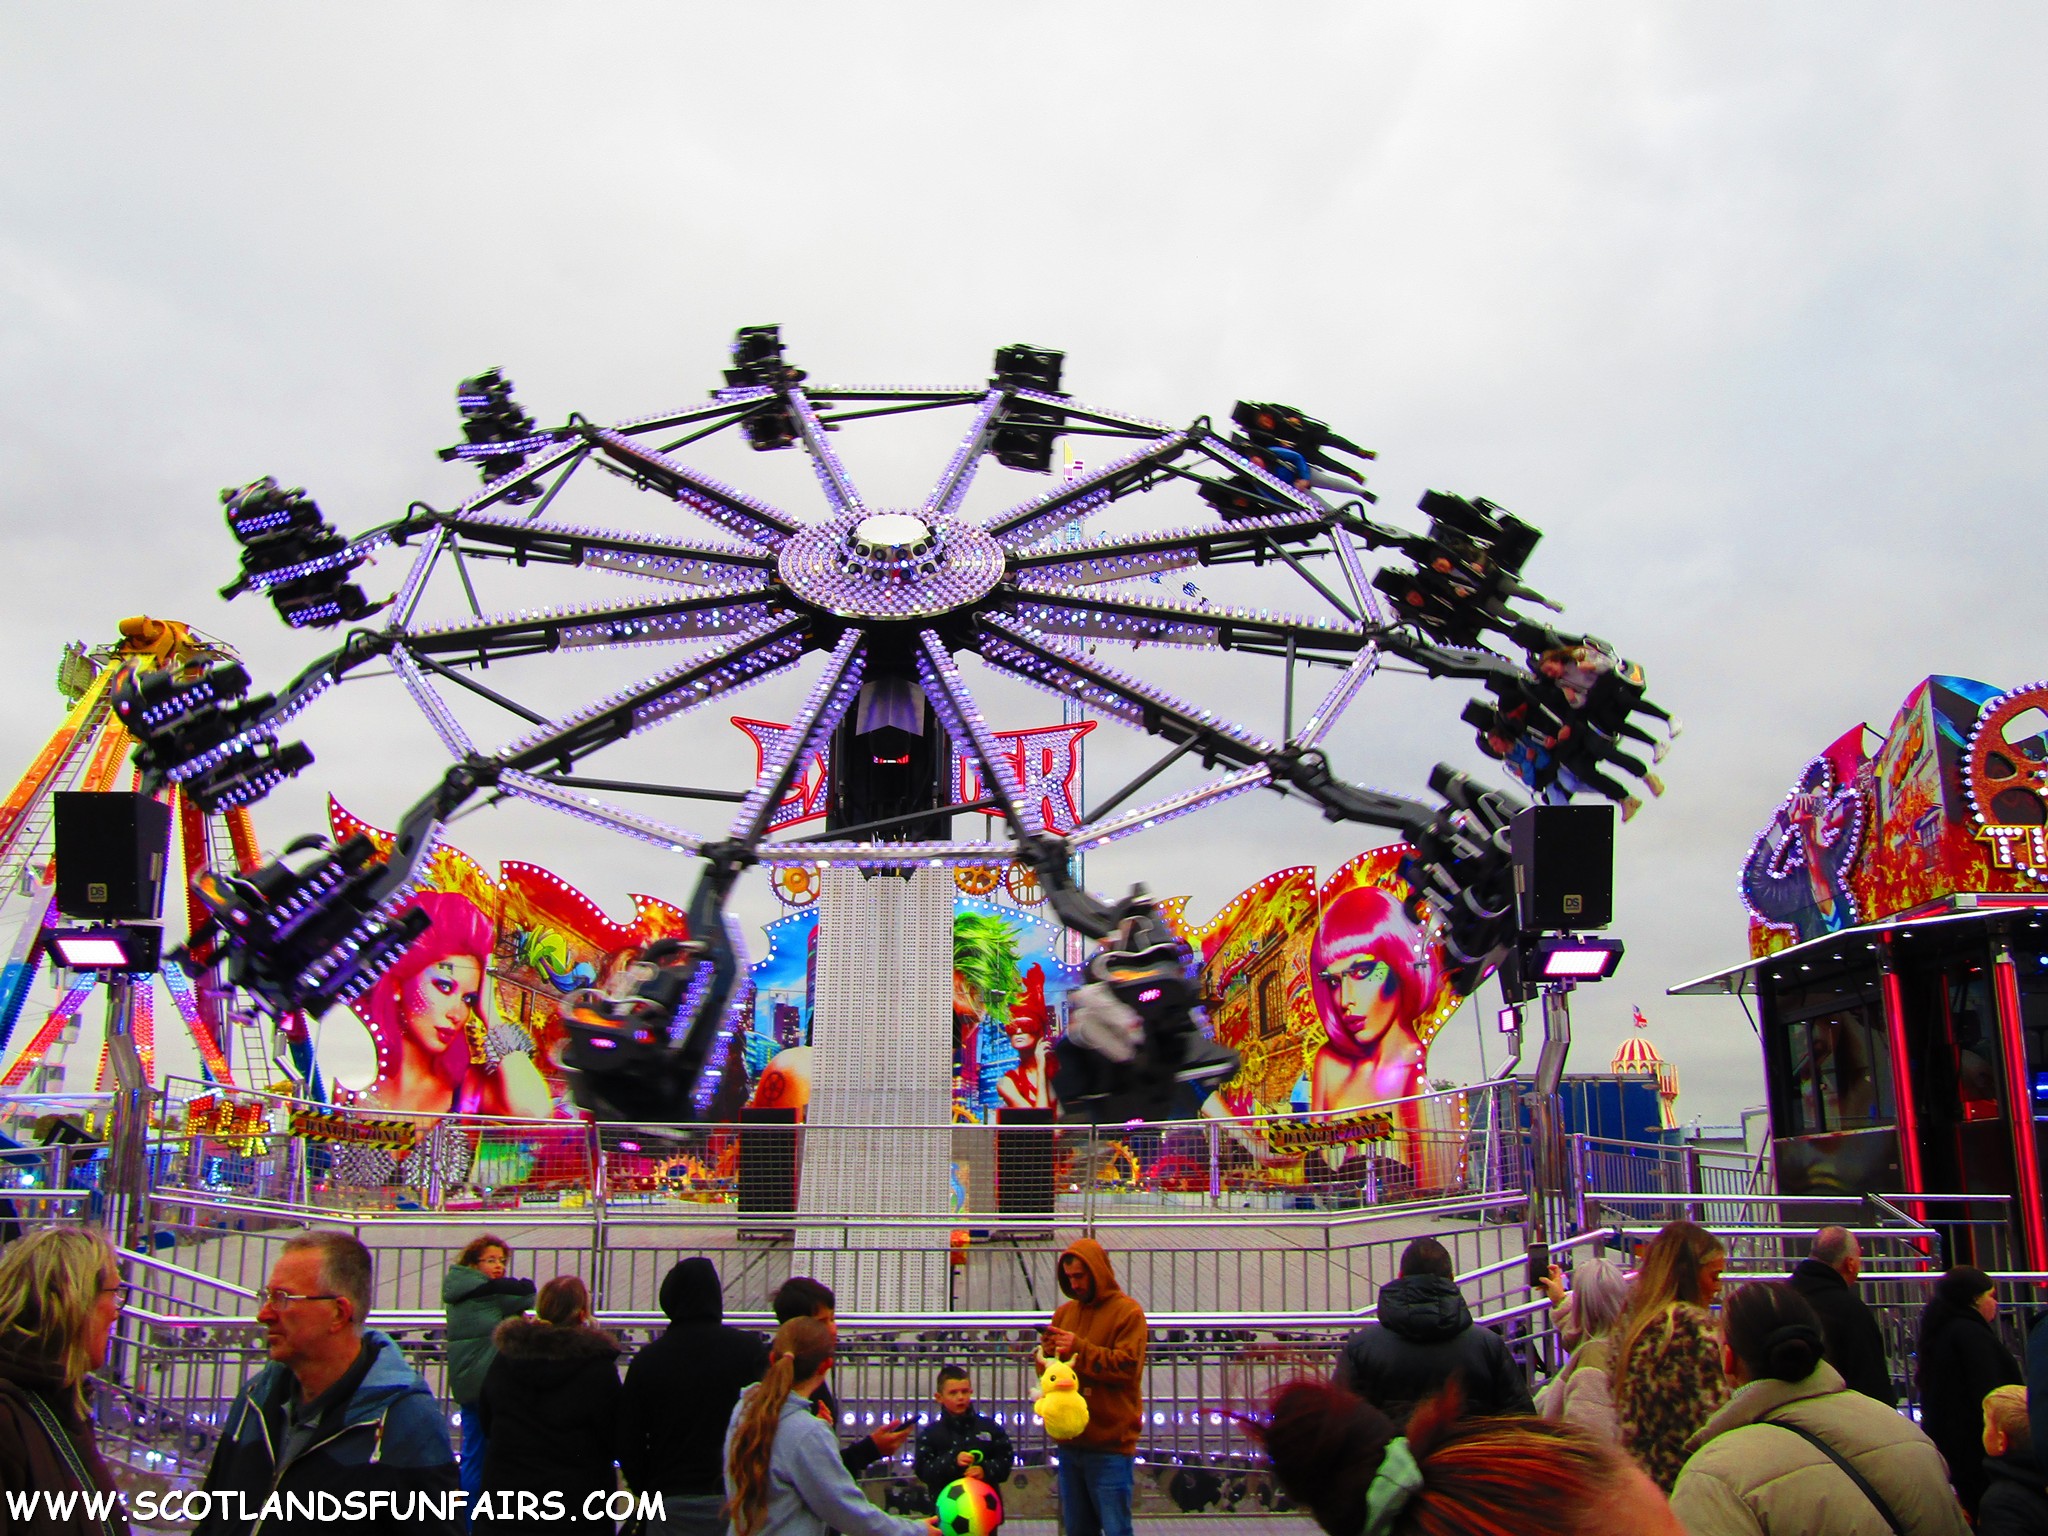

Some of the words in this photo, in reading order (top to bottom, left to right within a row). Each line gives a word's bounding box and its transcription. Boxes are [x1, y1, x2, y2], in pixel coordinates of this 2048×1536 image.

[1974, 825, 2048, 868] TI
[1565, 897, 1580, 907] DS
[305, 1119, 360, 1140] DANGER
[363, 1126, 401, 1142] ZONE
[1283, 1129, 1340, 1144] DANGER
[1344, 1122, 1379, 1139] ZONE
